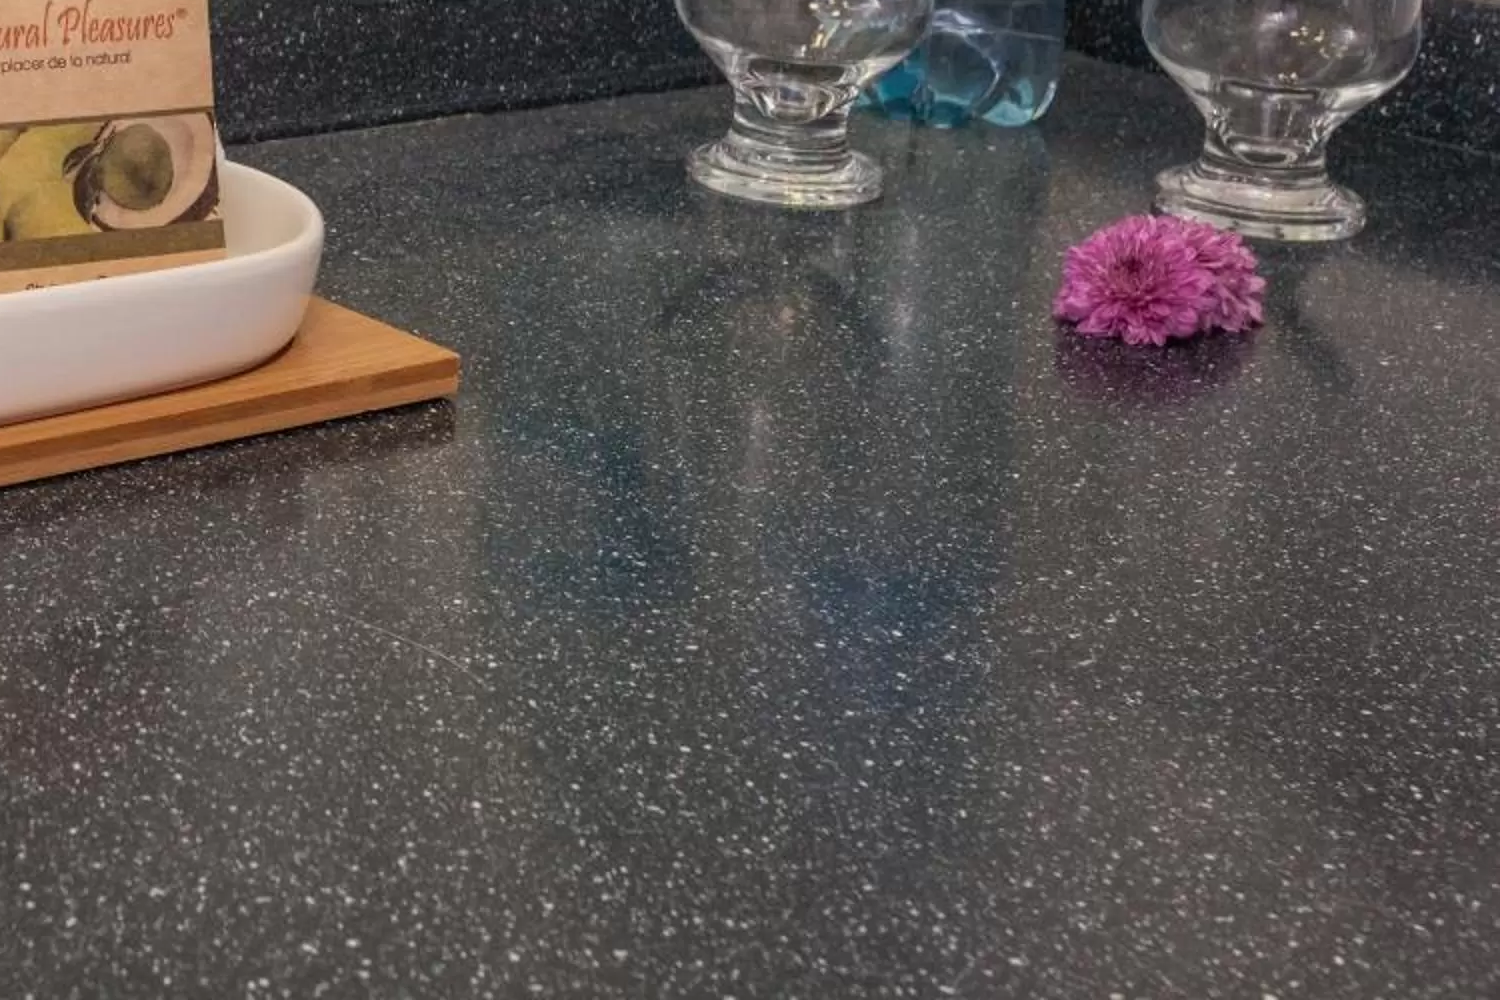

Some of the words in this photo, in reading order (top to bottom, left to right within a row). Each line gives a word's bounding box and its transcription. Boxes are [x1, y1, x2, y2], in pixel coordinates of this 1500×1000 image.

[1, 58, 46, 76] placer
[48, 55, 67, 70] de
[86, 49, 132, 66] natural
